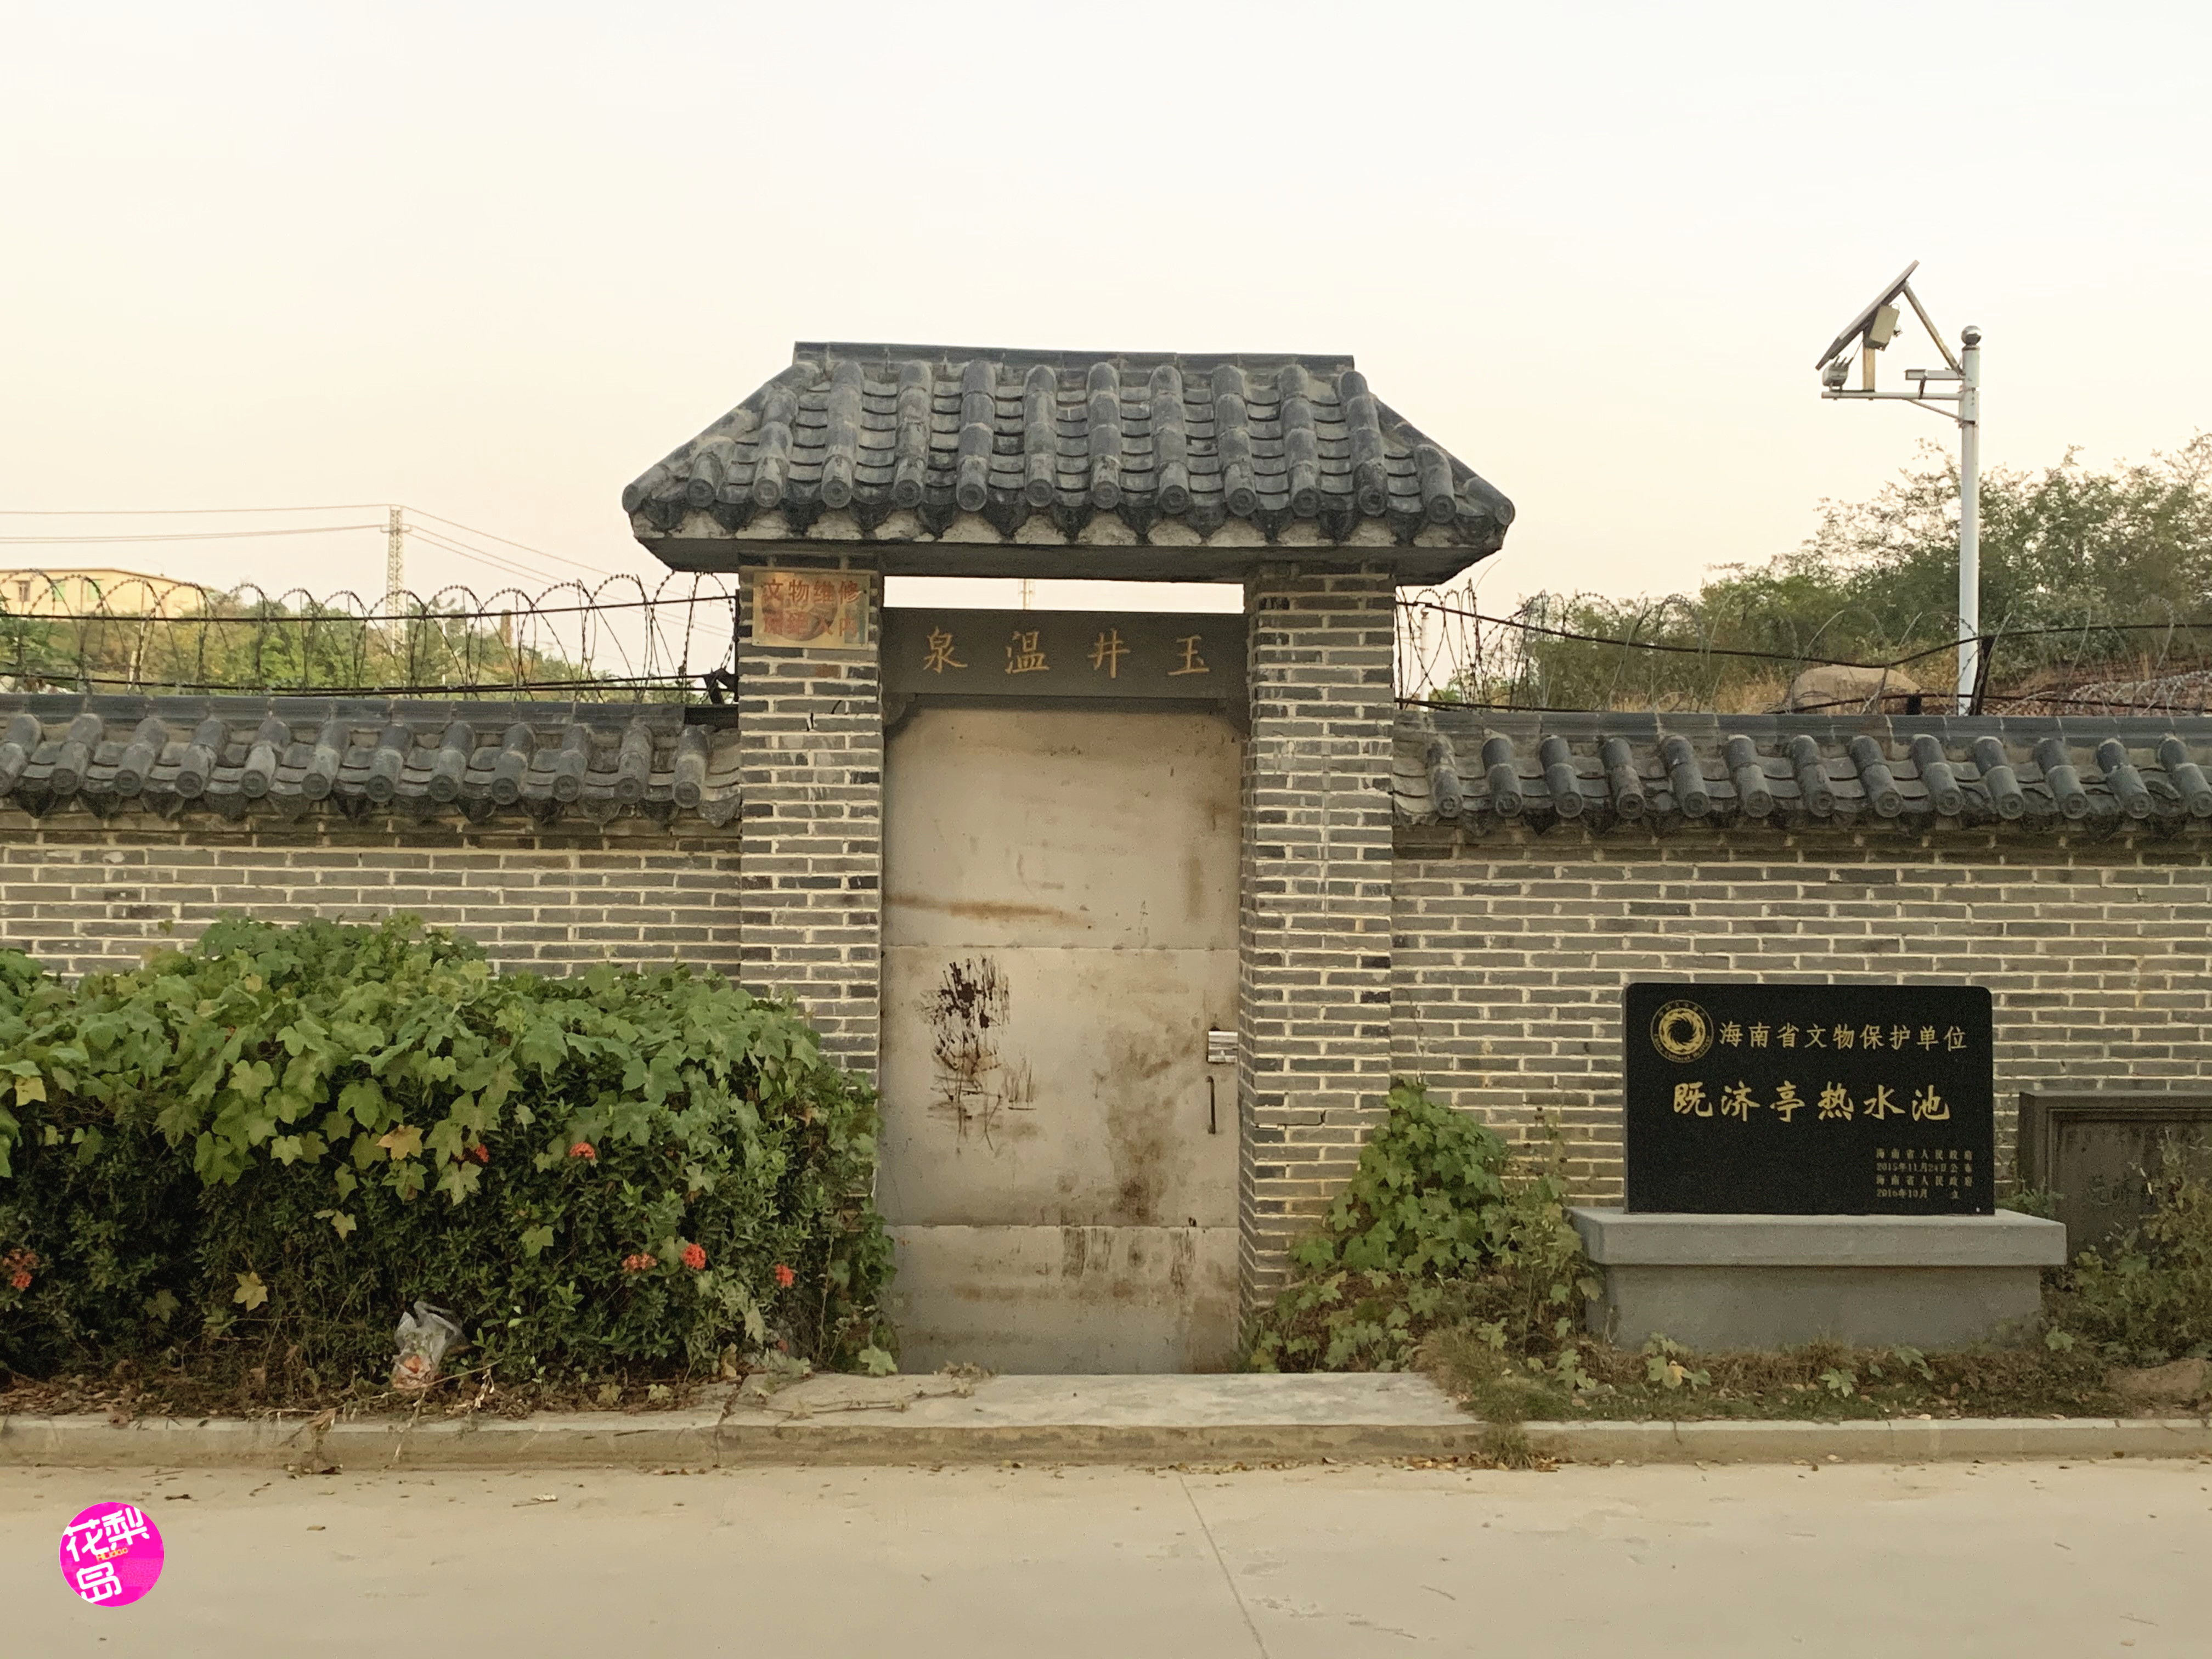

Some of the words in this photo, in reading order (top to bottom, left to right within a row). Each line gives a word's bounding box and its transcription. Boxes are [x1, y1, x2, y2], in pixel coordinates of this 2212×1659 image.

[763, 579, 860, 605] 文物维修
[1719, 1021, 1967, 1051] 海南省文物保护单位
[1673, 1080, 1951, 1122] 既济亭热水池
